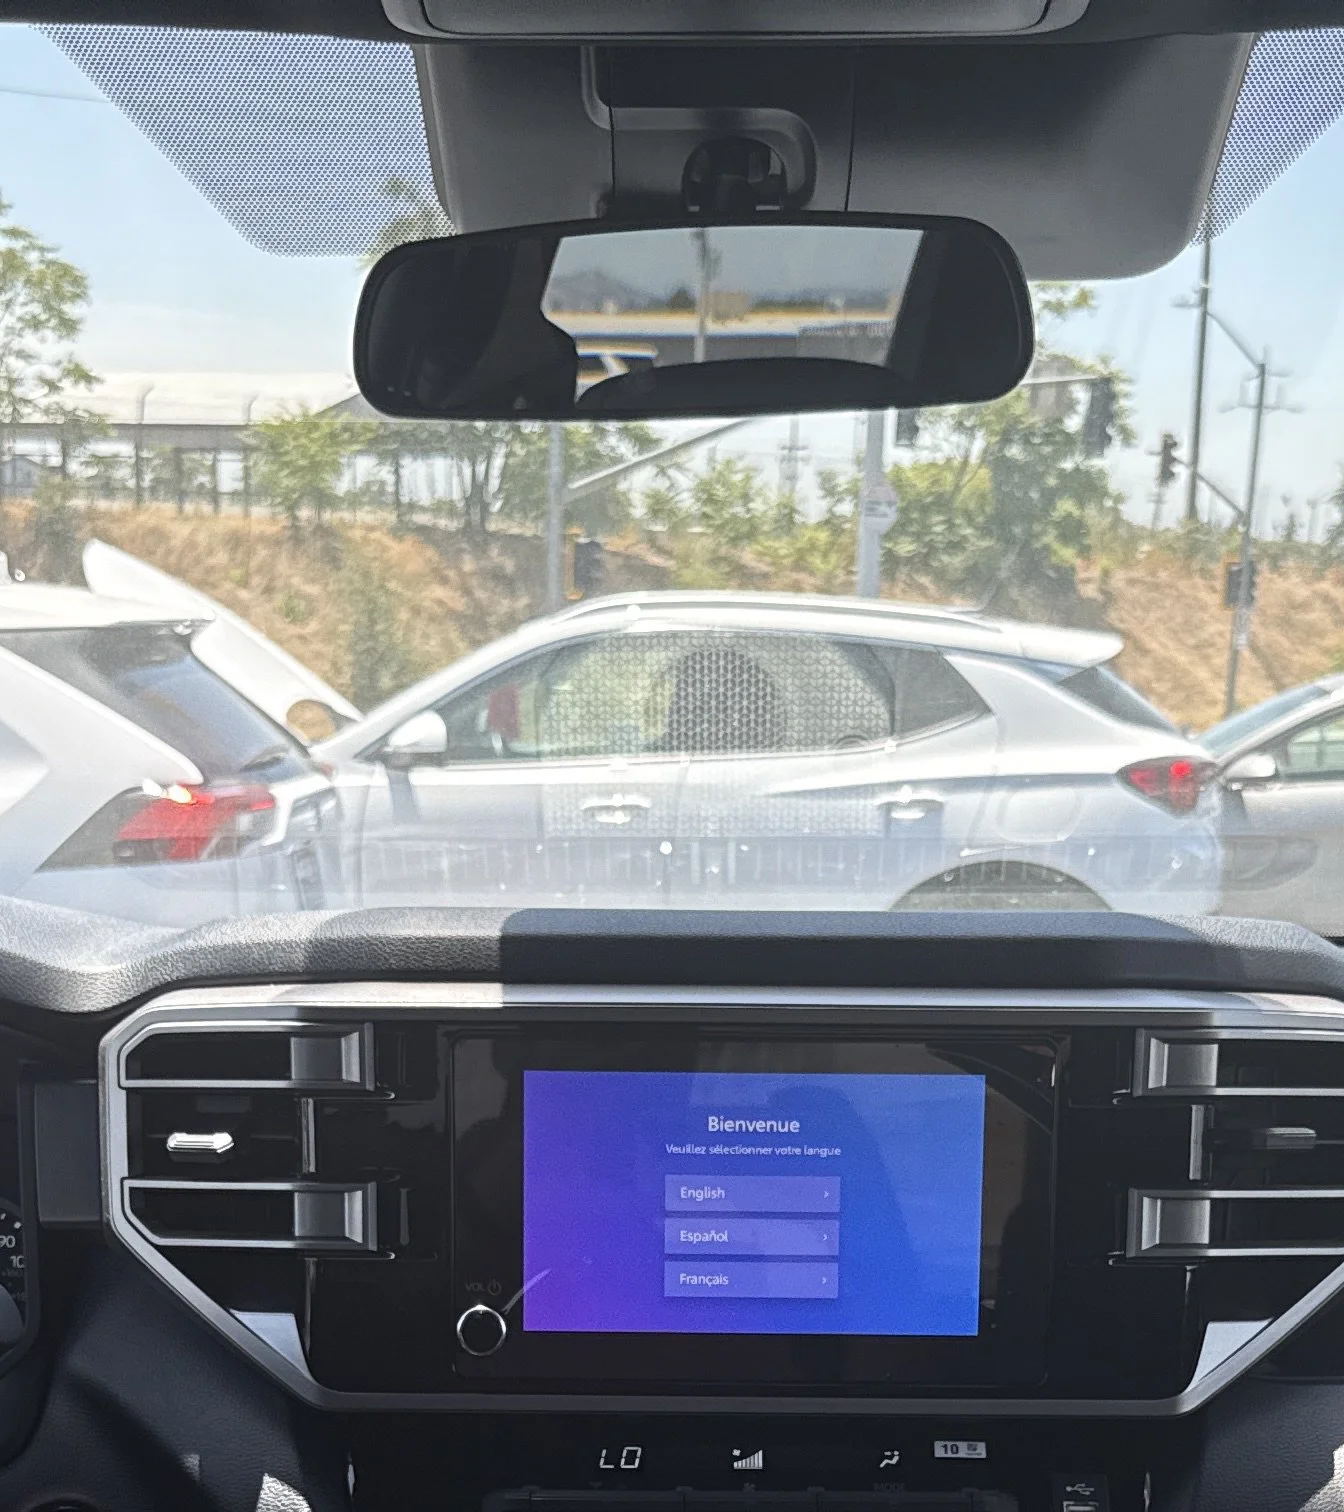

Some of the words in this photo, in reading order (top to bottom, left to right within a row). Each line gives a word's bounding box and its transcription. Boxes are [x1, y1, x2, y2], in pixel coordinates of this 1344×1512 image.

[707, 1115, 801, 1133] Bienvenue
[665, 1143, 706, 1155] Veuillez
[708, 1144, 773, 1156] sélectionner
[774, 1146, 802, 1156] votre
[803, 1145, 842, 1157] langue
[680, 1186, 726, 1202] English
[679, 1230, 729, 1244] Español
[464, 1282, 485, 1292] VOL
[679, 1273, 729, 1288] Français
[599, 1446, 642, 1470] LO
